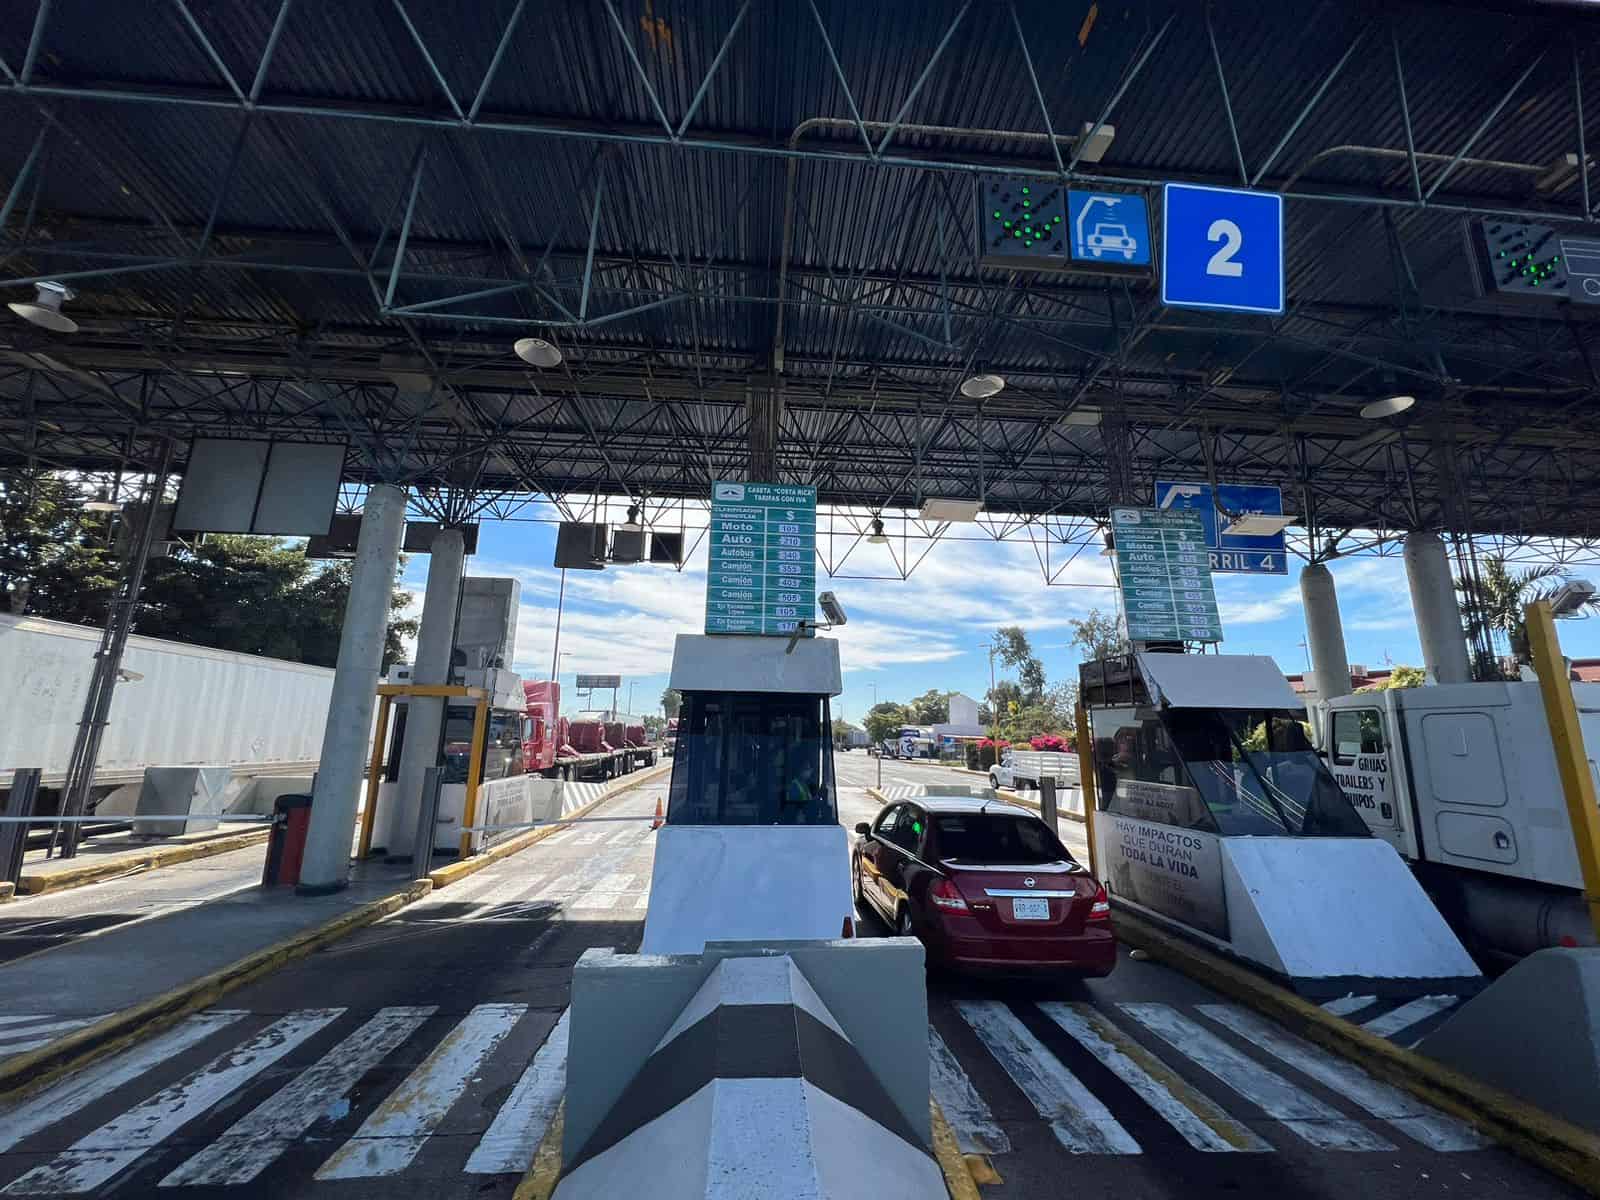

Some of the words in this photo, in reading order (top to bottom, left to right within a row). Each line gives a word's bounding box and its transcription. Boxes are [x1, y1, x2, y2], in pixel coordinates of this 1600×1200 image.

[1206, 219, 1244, 277] 2
[721, 522, 753, 531] Moto
[721, 534, 752, 544] Auto
[1129, 553, 1155, 562] Auto
[1209, 553, 1249, 570] RRIL
[1260, 555, 1275, 571] 4
[1359, 758, 1387, 773] GRUAS
[1335, 774, 1374, 790] TRAILERS
[1377, 777, 1386, 792] Y
[1115, 821, 1137, 835] HAY
[1138, 826, 1203, 851] IMPACTOS
[1123, 835, 1146, 850] QUE
[1149, 840, 1193, 863] DURAN
[1120, 845, 1148, 864] TODA
[1149, 854, 1165, 869] LA
[1167, 858, 1200, 880] VIDA
